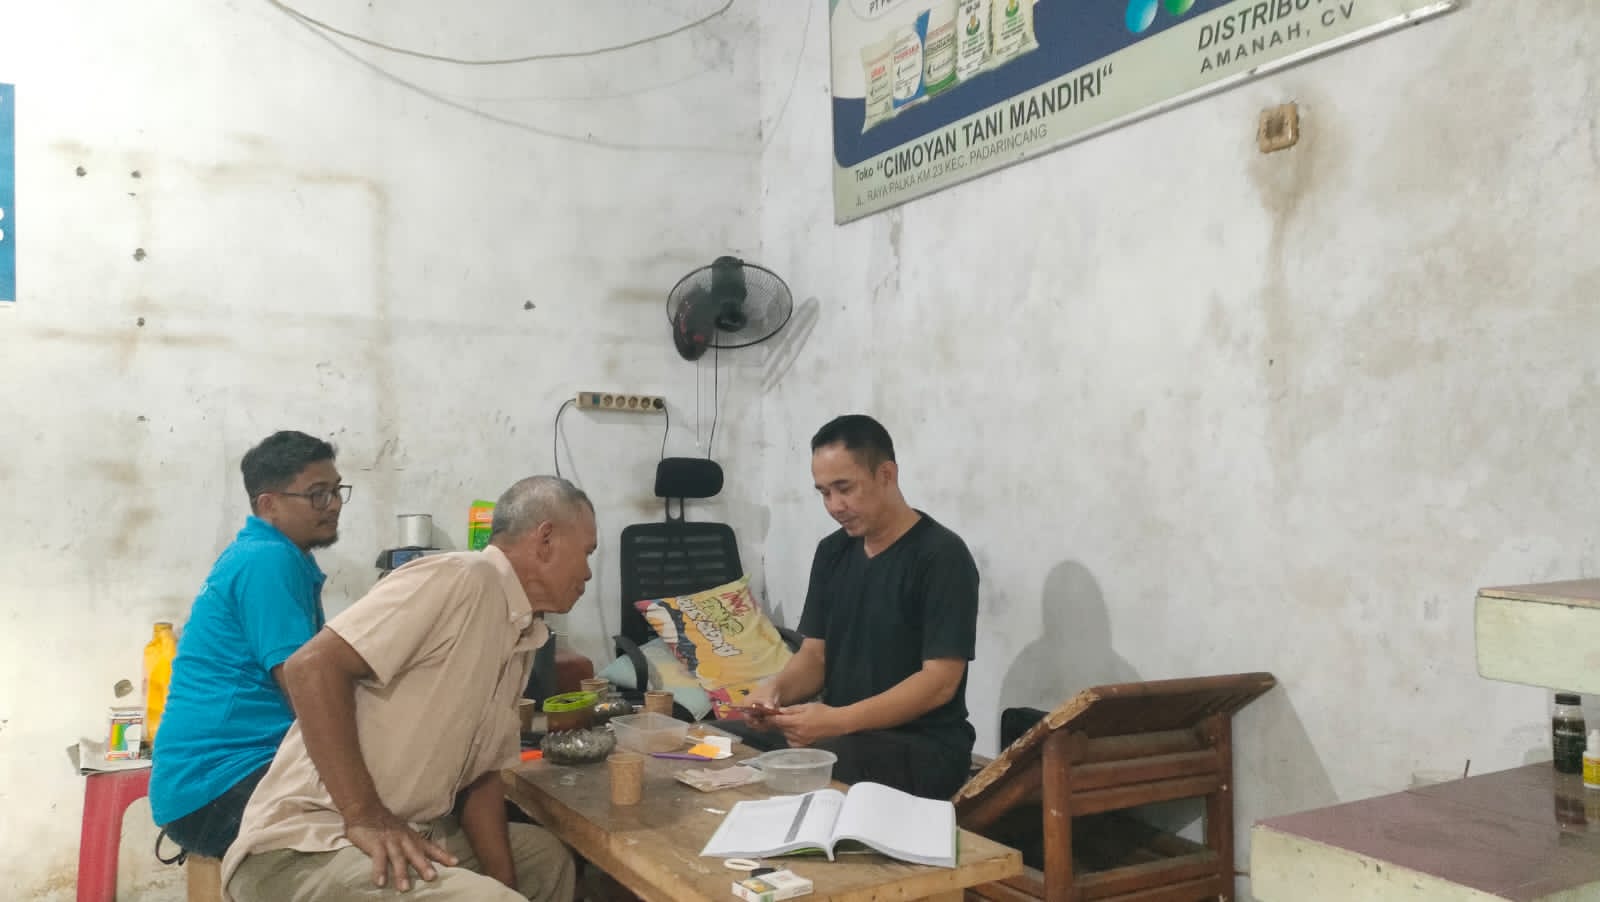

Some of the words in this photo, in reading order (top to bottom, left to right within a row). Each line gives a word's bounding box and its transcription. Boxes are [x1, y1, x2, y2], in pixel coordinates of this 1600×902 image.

[1198, 0, 1323, 51] DISTRIB
[1200, 21, 1310, 73] AMANAH,
[1321, 1, 1354, 27] CV
[855, 167, 874, 183] Toko
[962, 109, 1003, 148] TANI
[867, 185, 888, 201] RAYA
[889, 176, 915, 193] PALKA
[917, 171, 931, 185] KM
[932, 165, 943, 180] 23
[944, 155, 968, 174] KEC.
[969, 123, 1048, 164] PADARINCANG
